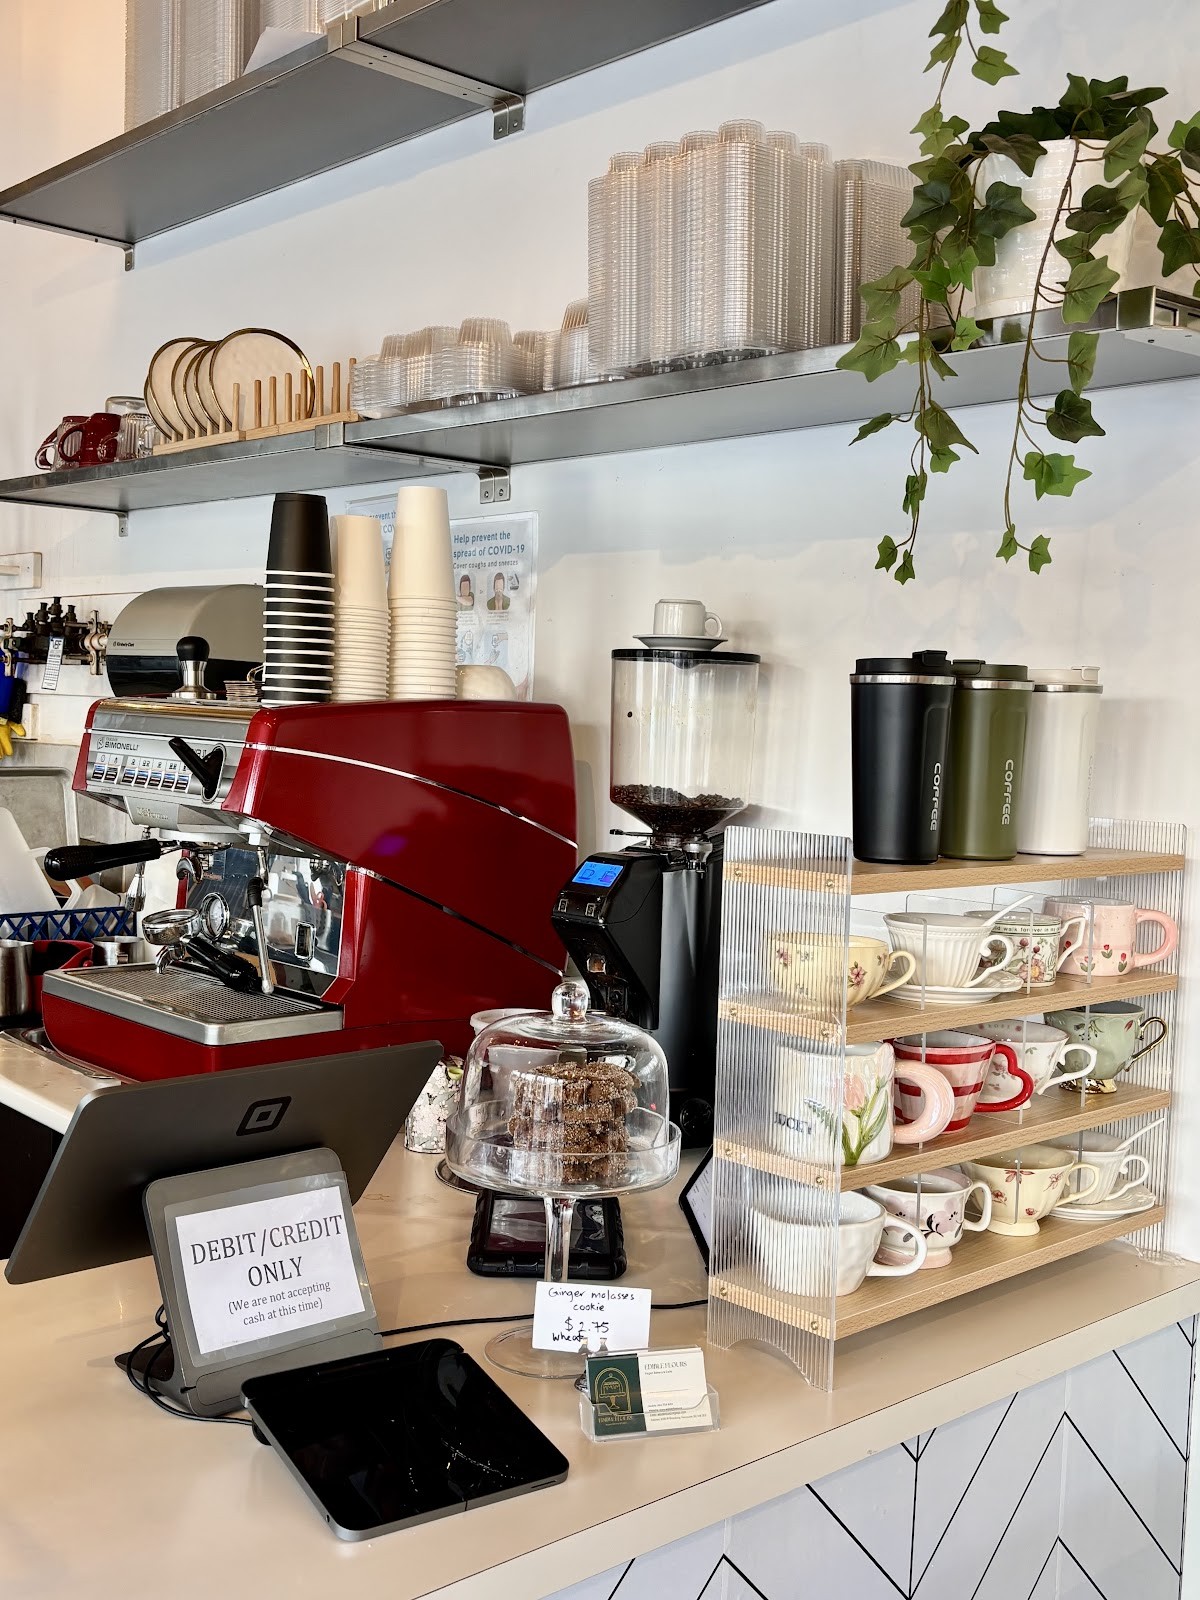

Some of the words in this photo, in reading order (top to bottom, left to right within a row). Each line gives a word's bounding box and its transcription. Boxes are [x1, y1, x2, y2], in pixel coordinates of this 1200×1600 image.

[453, 534, 469, 545] Help
[472, 532, 498, 545] prevent
[500, 531, 511, 540] the
[453, 547, 477, 560] spread
[478, 546, 486, 556] of
[487, 544, 525, 556] COVID-19
[452, 562, 468, 570] Cover
[468, 561, 486, 570] coughs
[487, 560, 498, 568] and
[498, 559, 518, 567] sneezes
[104, 741, 139, 751] SIMONELLI
[930, 762, 941, 831] COFFEE
[1002, 759, 1014, 825] COFFEE
[190, 1215, 342, 1265] DEBIT/CREDIT
[248, 1257, 303, 1287] ONLY
[228, 1299, 250, 1315] (We
[251, 1295, 268, 1308] are
[269, 1291, 286, 1303] not
[287, 1281, 331, 1300] accepting
[548, 1287, 586, 1302] Ginger
[591, 1289, 635, 1301] molasses
[243, 1312, 265, 1325] cash
[267, 1308, 277, 1320] at
[279, 1303, 297, 1317] this
[298, 1297, 323, 1313] time)
[572, 1302, 605, 1312] cookie
